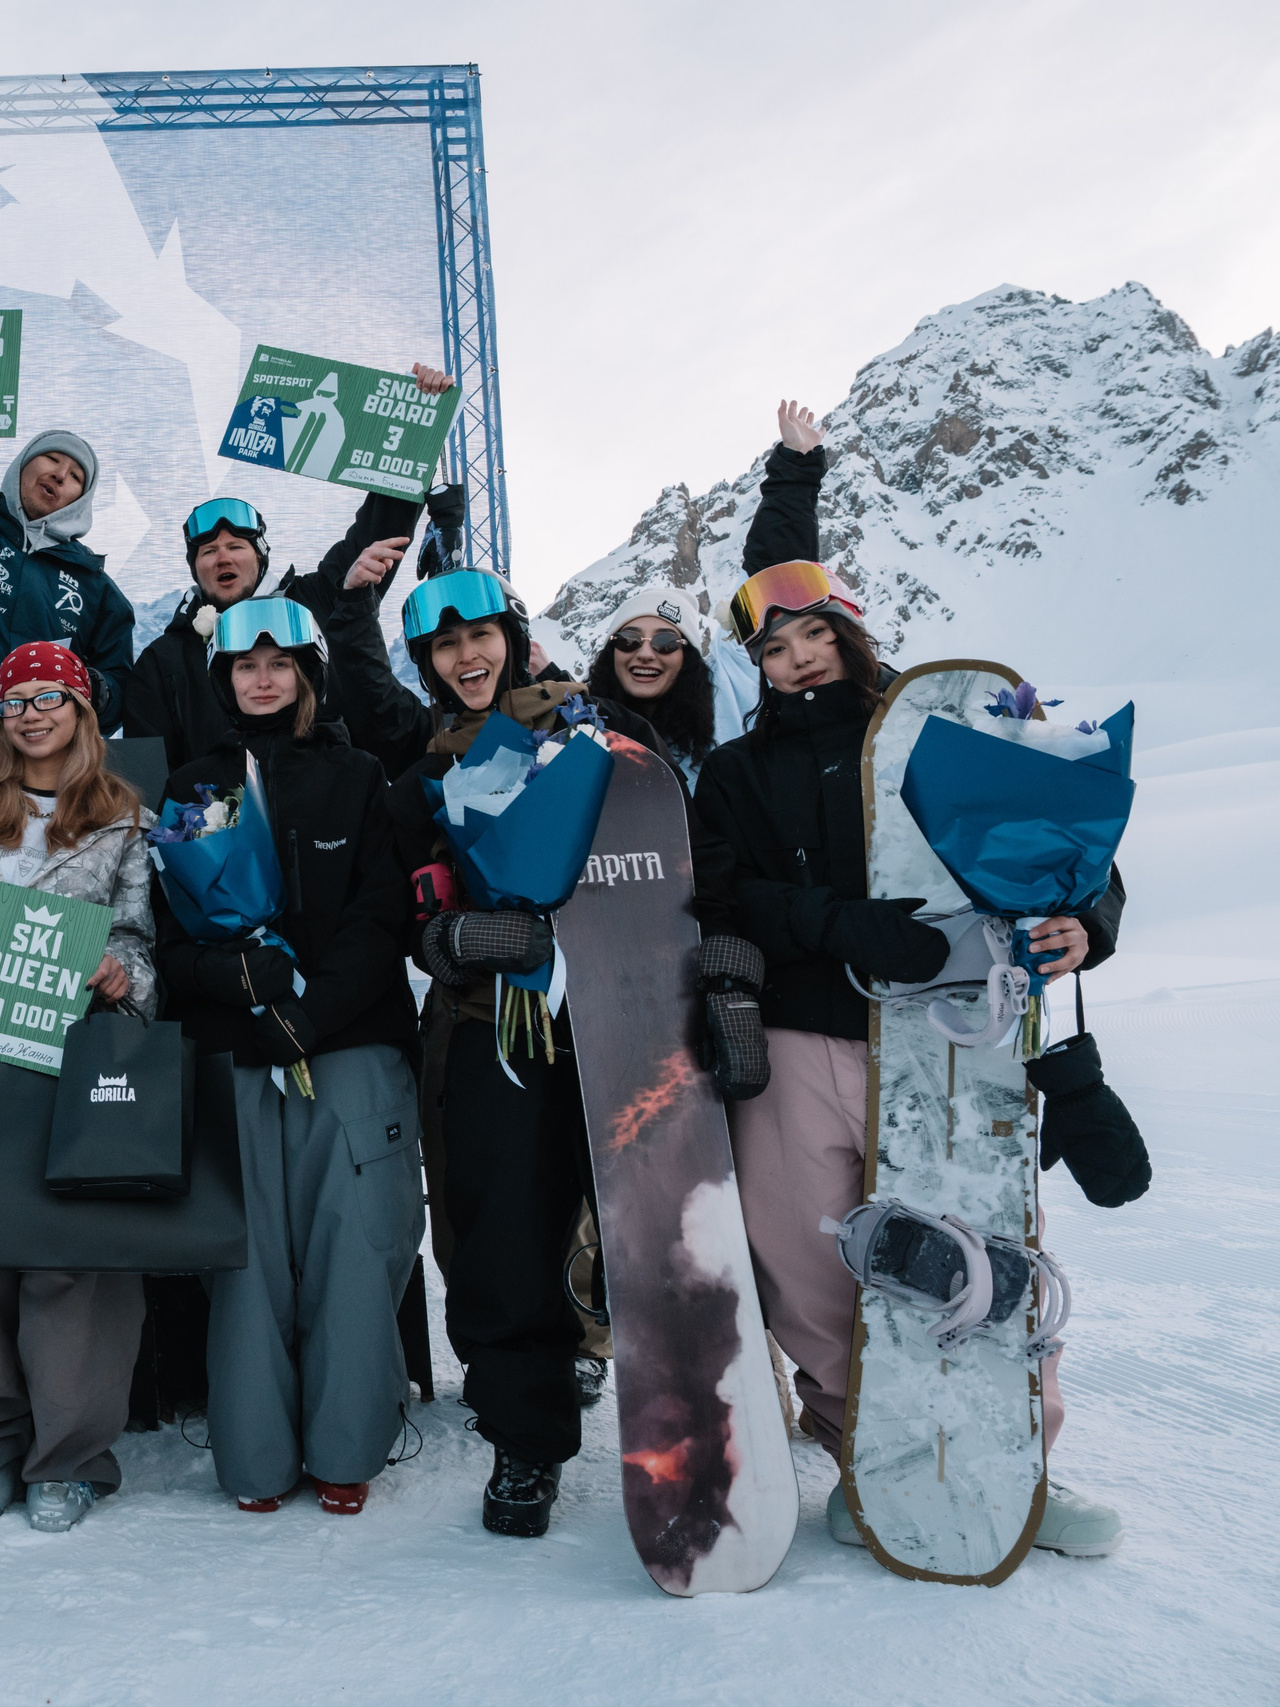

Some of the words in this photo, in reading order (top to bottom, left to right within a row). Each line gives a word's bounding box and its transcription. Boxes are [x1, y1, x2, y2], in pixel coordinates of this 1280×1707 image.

[253, 374, 313, 388] SPOT2SPOT
[376, 378, 442, 406] SNOW
[363, 394, 438, 427] BOARD
[229, 427, 277, 455] IMBA
[248, 423, 267, 432] GORILLA
[382, 425, 405, 452] 3
[238, 448, 258, 459] PARK
[350, 449, 375, 467] 60
[379, 455, 414, 475] 000
[10, 922, 64, 960] SKI
[10, 1002, 58, 1032] 000
[90, 1087, 136, 1102] GORILLA
